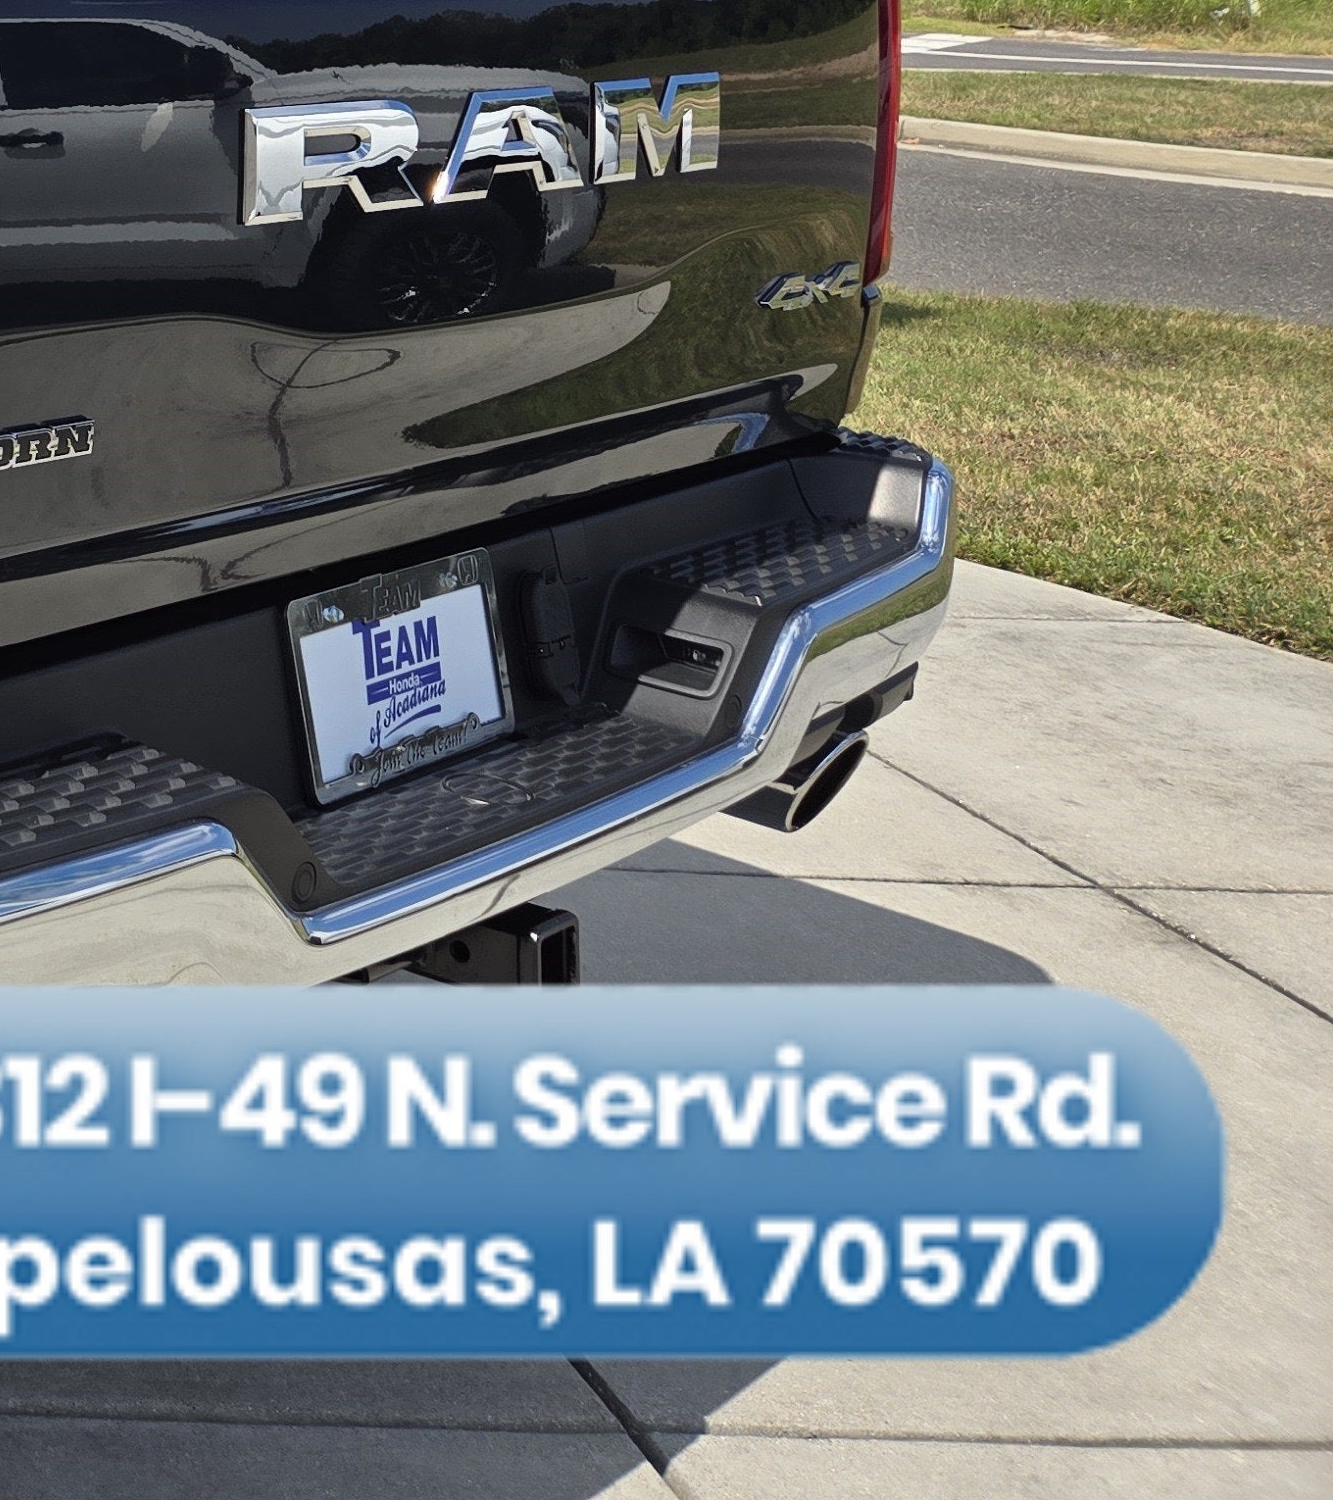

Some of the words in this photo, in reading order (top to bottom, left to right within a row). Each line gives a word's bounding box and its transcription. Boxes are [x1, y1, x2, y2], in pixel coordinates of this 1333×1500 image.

[244, 71, 721, 226] RAM
[352, 615, 440, 681] TEAM
[369, 710, 382, 749] of
[383, 678, 446, 728] Acadiana
[389, 673, 421, 695] Honda
